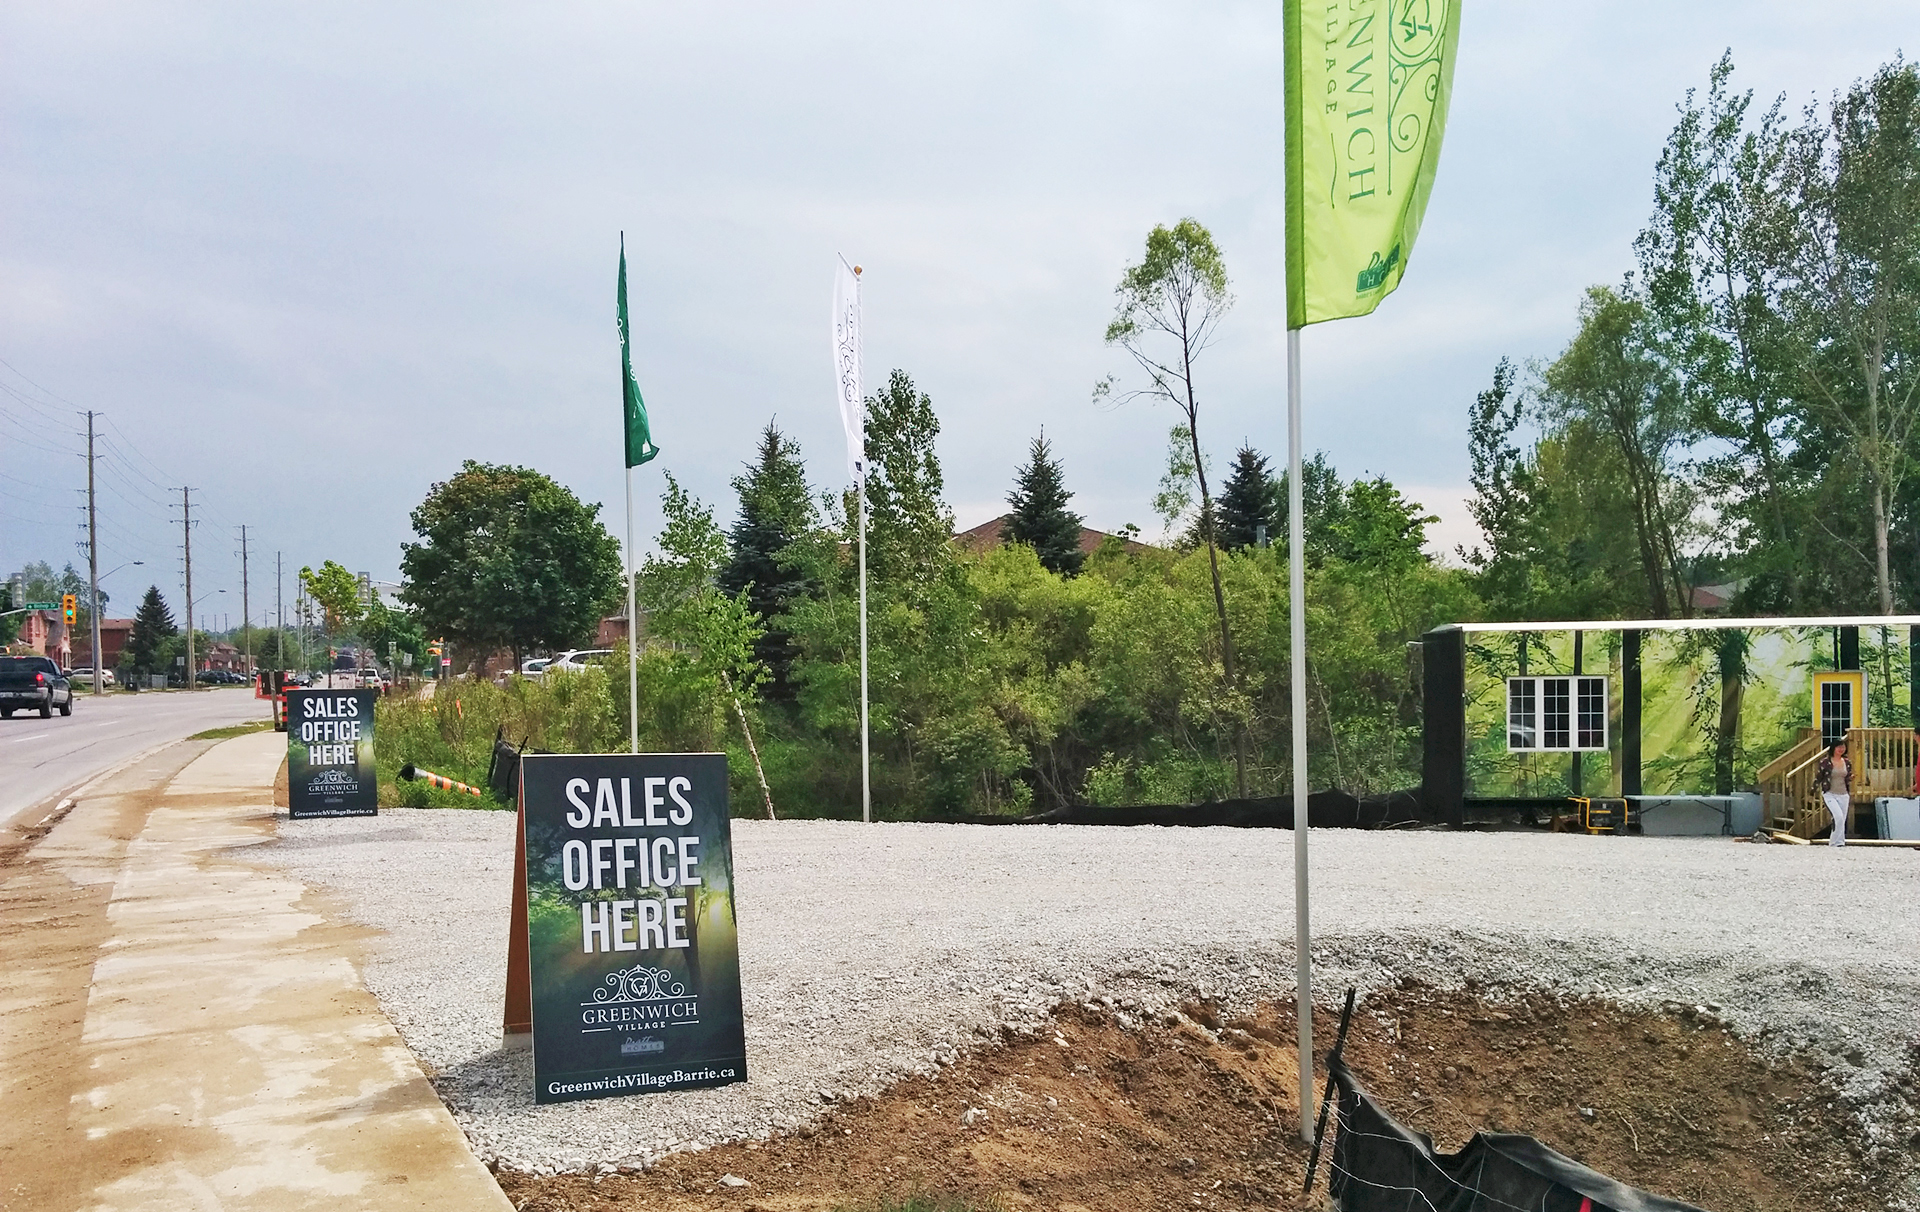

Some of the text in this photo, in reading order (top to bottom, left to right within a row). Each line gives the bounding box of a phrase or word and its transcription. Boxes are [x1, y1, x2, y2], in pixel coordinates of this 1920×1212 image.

[303, 697, 358, 718] SALES
[301, 720, 361, 742] OFFICE
[309, 744, 356, 766] HERE
[308, 784, 358, 793] GREENWICH
[294, 808, 374, 817] GreenwichVillageBarrie.ca
[565, 776, 693, 829] SALES
[562, 836, 702, 892] OFFICE
[582, 898, 690, 954] HERE
[582, 1002, 698, 1025] GREENWICH
[617, 1021, 666, 1031] VILLAGE
[548, 1067, 735, 1095] GreenwichVillageBarrie.ca
